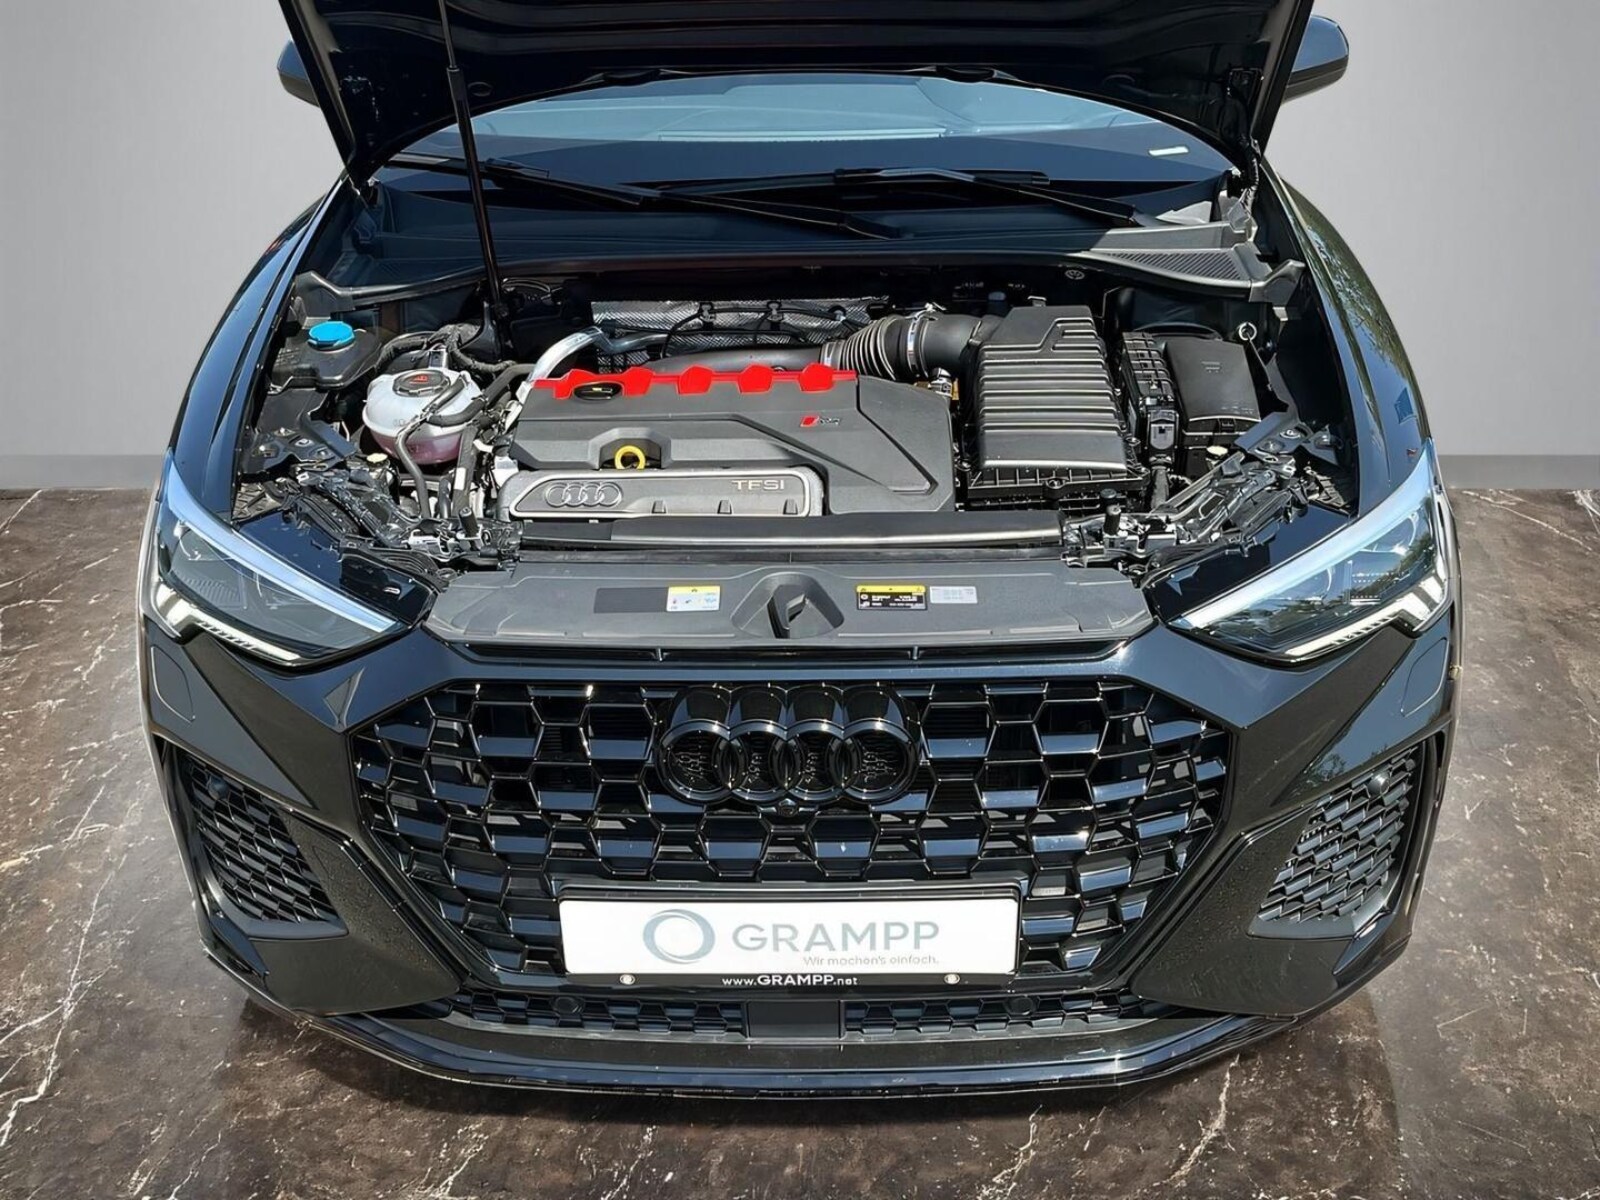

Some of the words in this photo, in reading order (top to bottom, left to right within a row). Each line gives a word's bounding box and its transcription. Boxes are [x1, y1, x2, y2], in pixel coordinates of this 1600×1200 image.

[731, 479, 785, 490] TFSI
[732, 921, 940, 952] GRAMPP
[803, 955, 824, 966] Wir
[722, 974, 858, 986] www.GRAMPP.net
